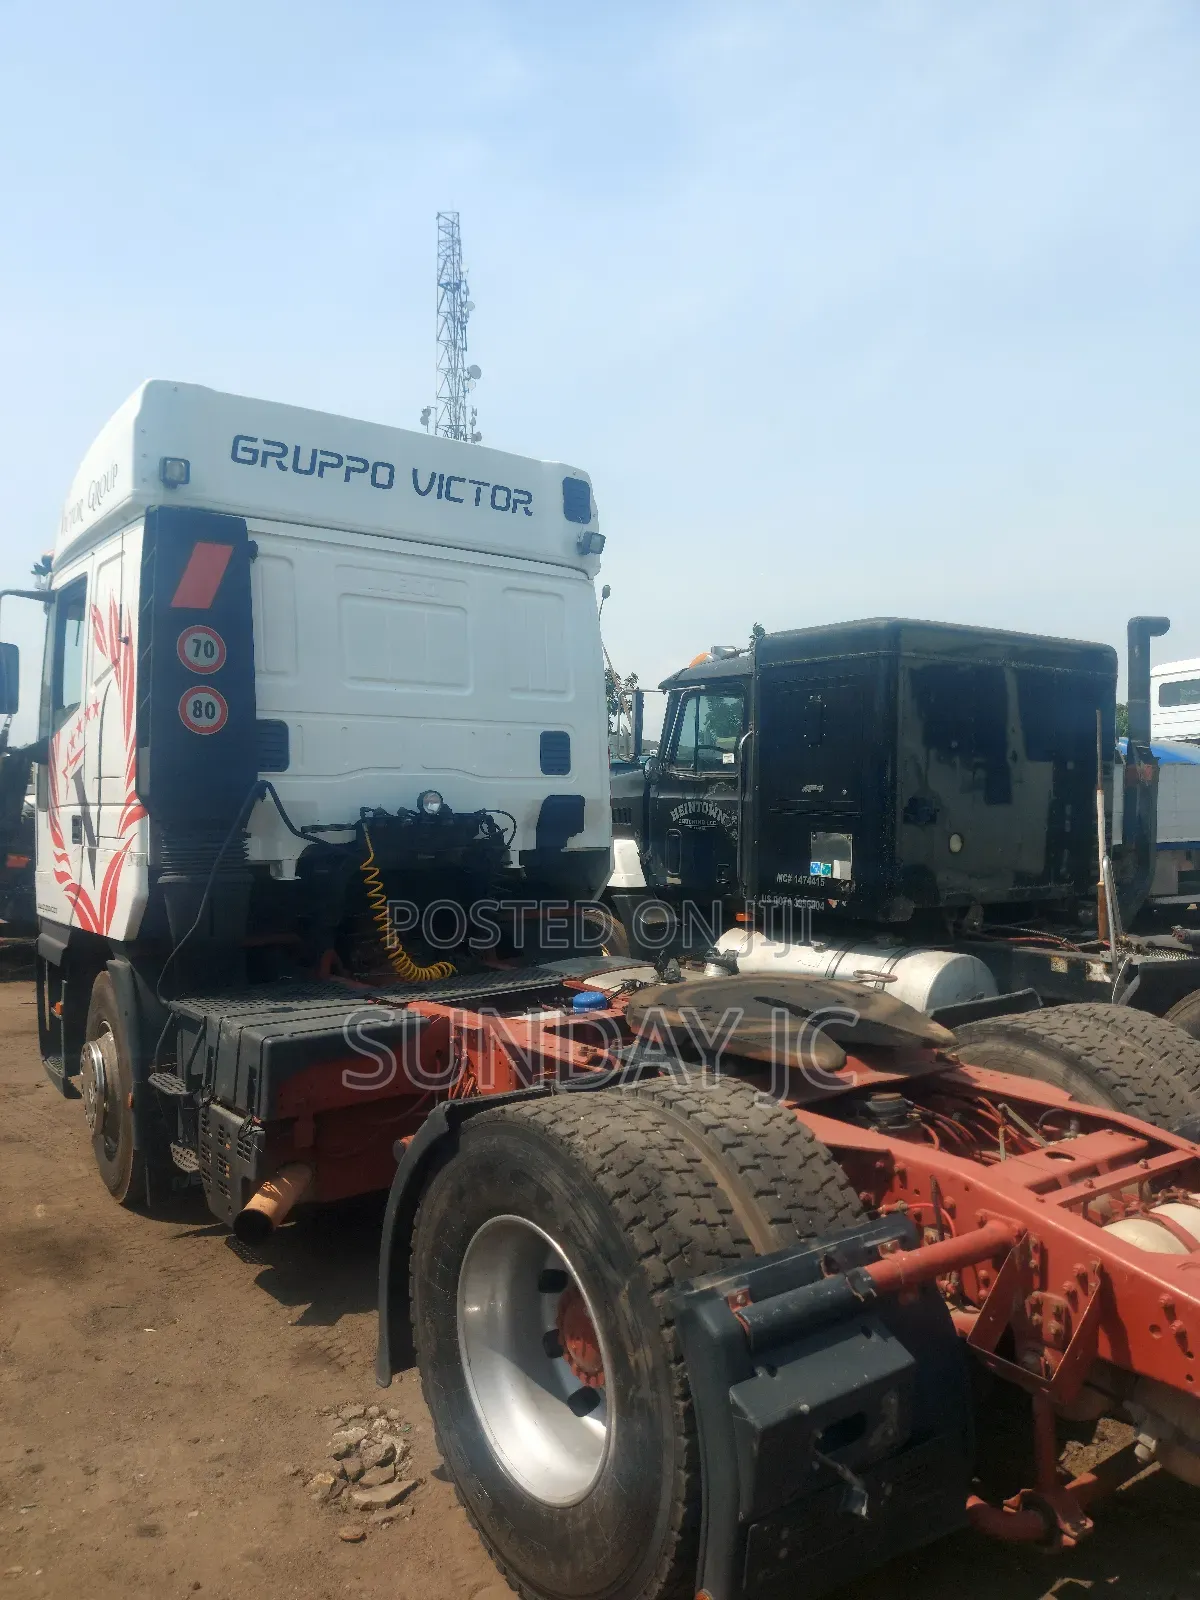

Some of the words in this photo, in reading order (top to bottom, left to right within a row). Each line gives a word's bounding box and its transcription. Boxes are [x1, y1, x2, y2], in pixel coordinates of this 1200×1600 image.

[231, 435, 395, 489] GRUPPO
[412, 467, 533, 516] VICTOR
[192, 639, 215, 659] 70
[192, 700, 216, 720] 80
[795, 875, 825, 887] 1474415
